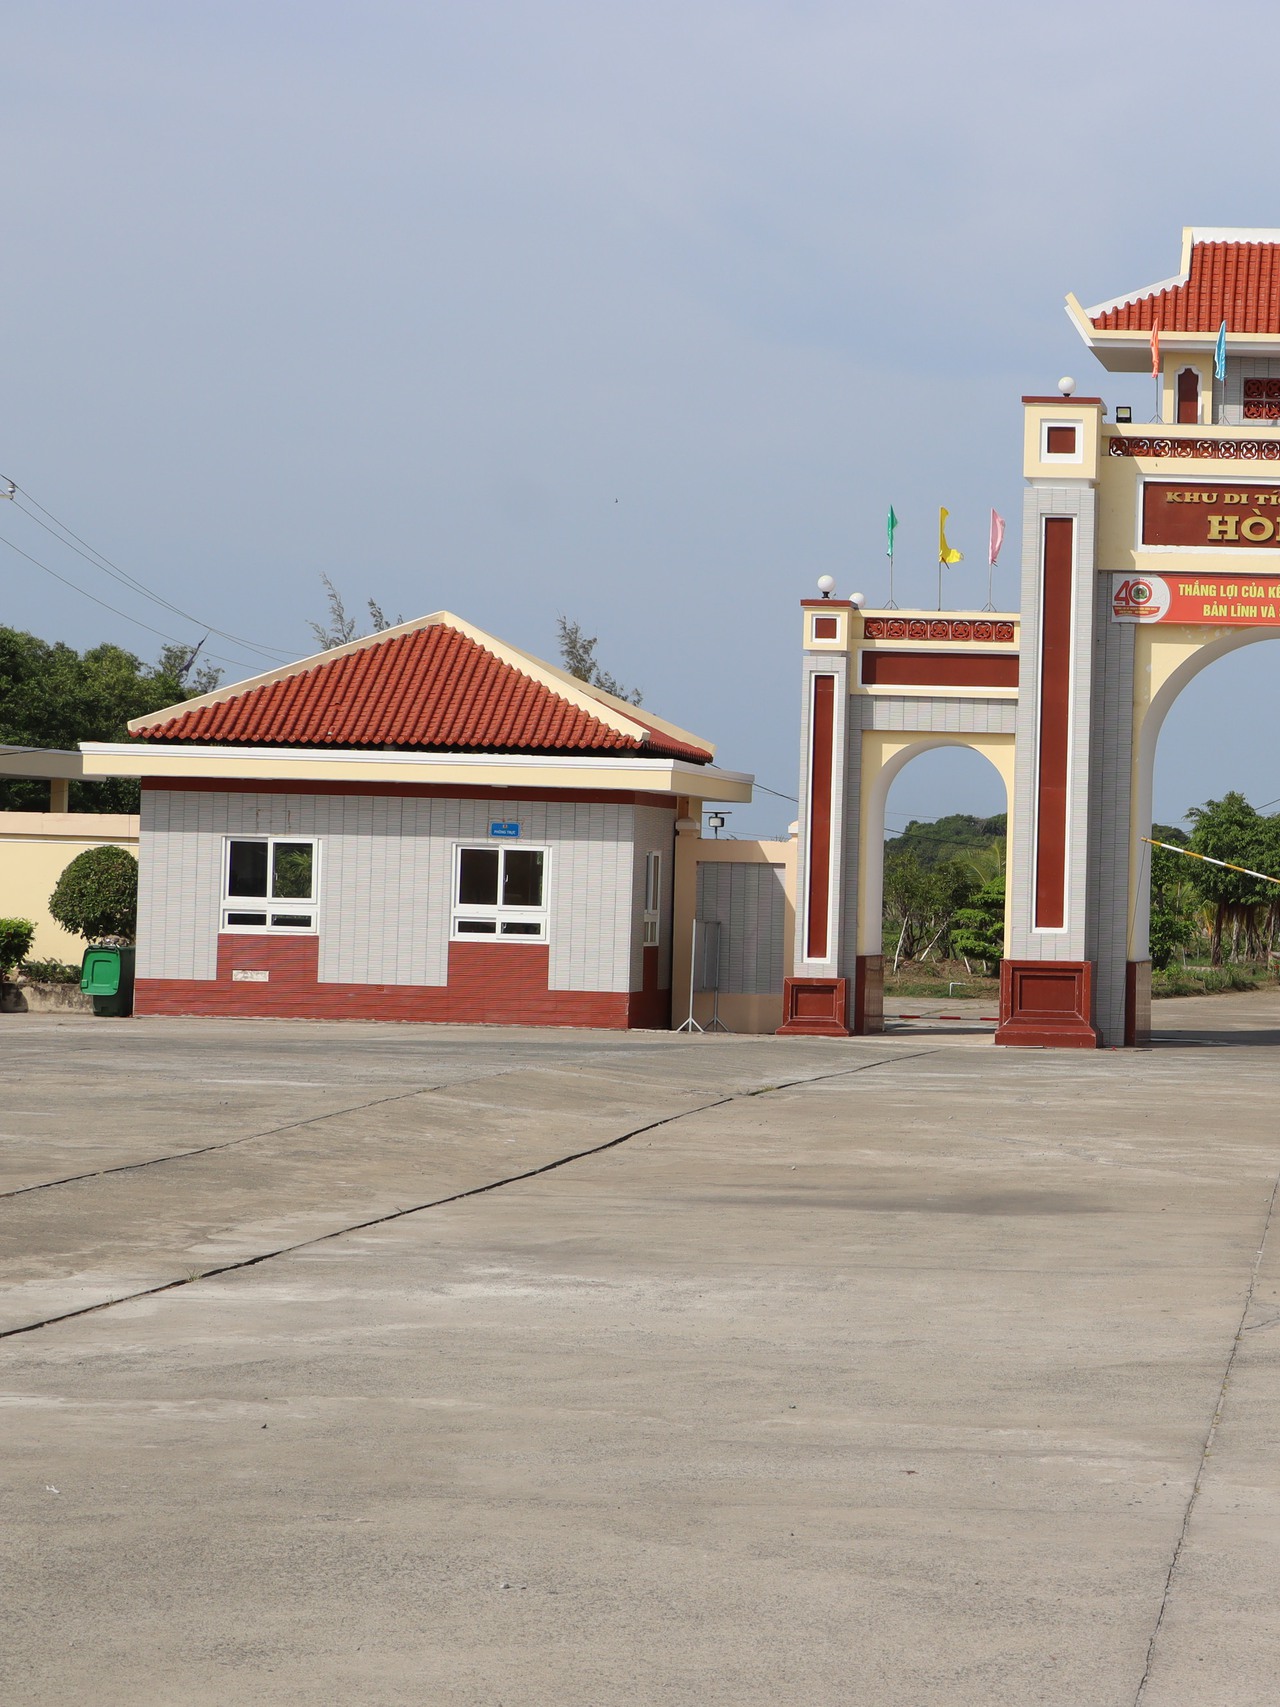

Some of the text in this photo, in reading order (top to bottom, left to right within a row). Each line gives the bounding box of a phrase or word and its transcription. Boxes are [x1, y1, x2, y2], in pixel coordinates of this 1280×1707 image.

[1166, 491, 1218, 504] KHU
[1223, 493, 1249, 505] DI
[1113, 580, 1153, 606] 40
[1178, 580, 1217, 597] THẮNG
[1220, 584, 1238, 600] LỢI
[1241, 582, 1265, 598] CỦA
[1203, 600, 1228, 617] BẢN
[1230, 603, 1257, 618] LĨNH
[1260, 604, 1276, 618] VÀ
